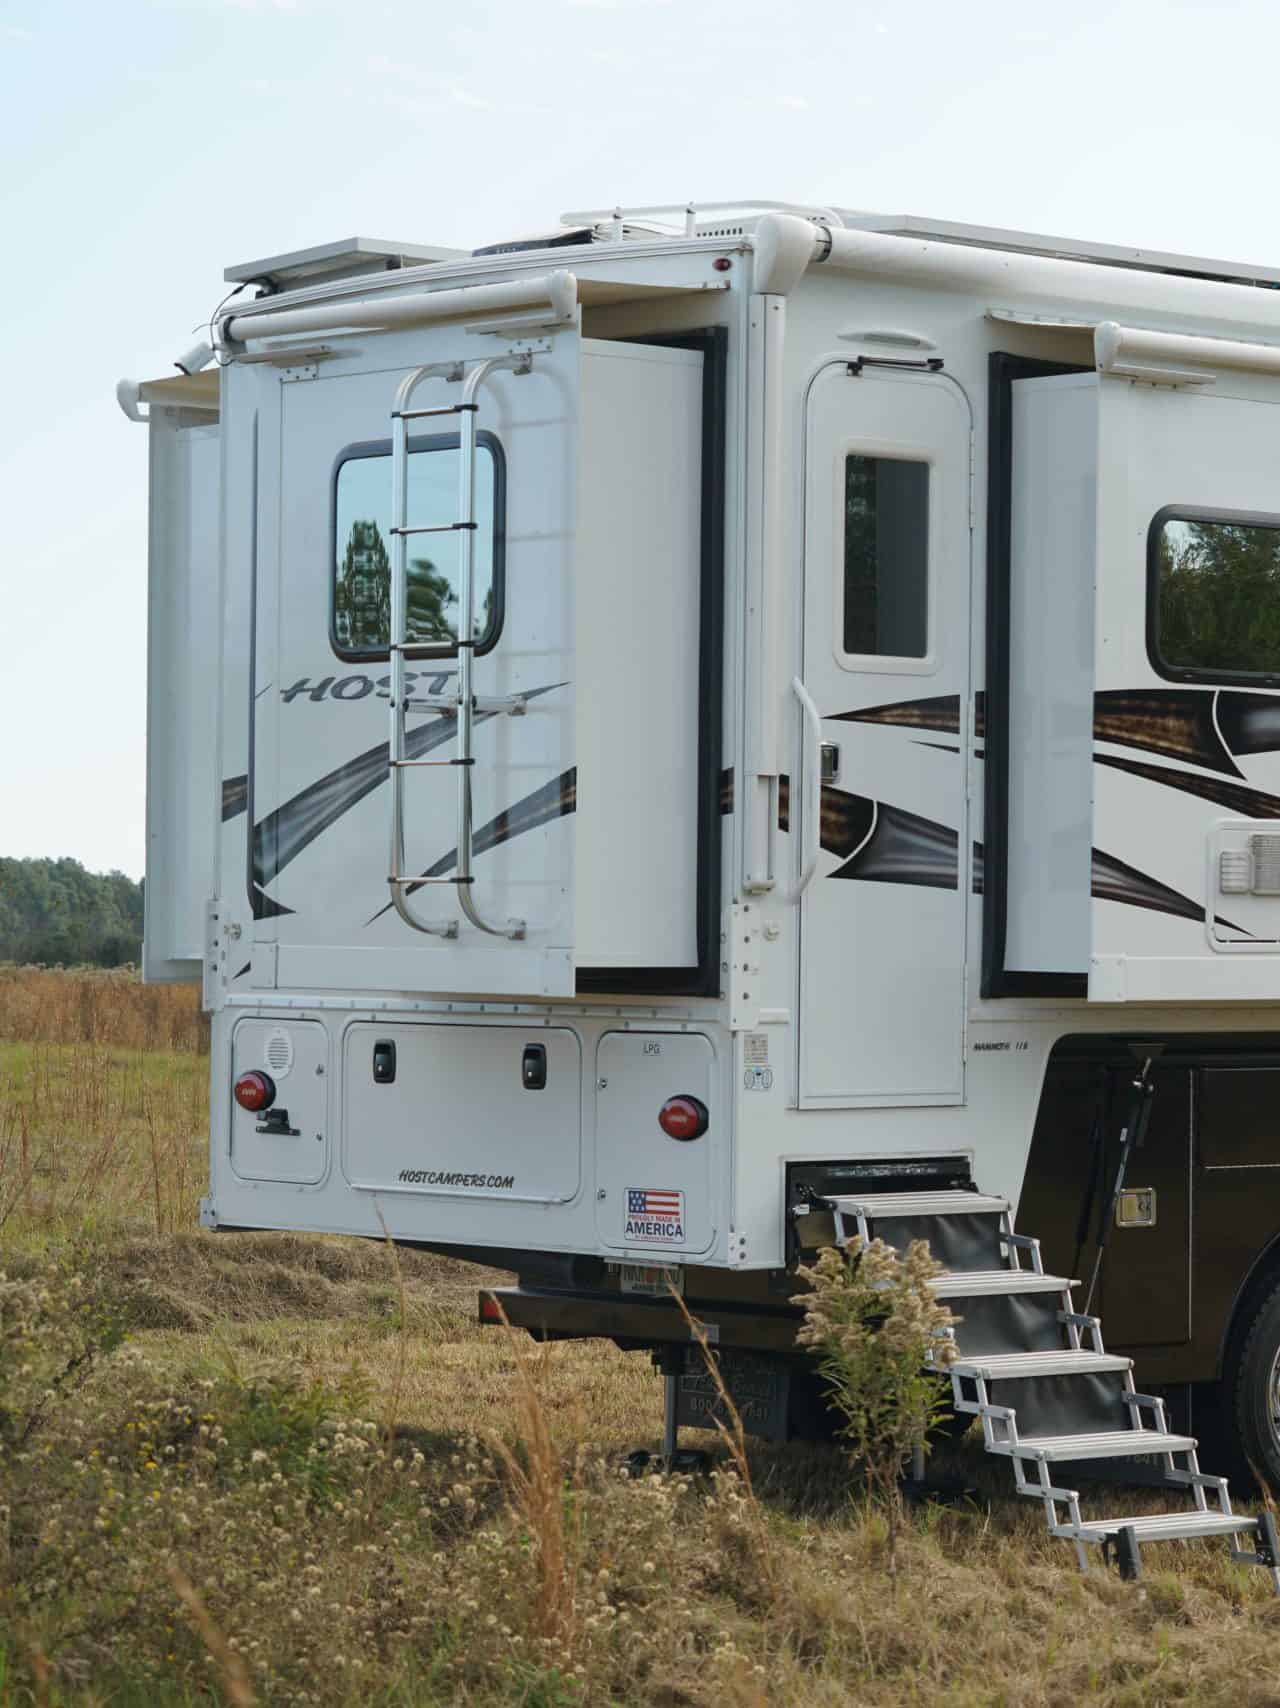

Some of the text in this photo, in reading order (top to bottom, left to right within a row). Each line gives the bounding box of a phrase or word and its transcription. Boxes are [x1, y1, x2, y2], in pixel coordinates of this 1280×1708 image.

[280, 670, 458, 703] HOST
[643, 1043, 661, 1054] LPG
[625, 1221, 683, 1237] AMERICA
